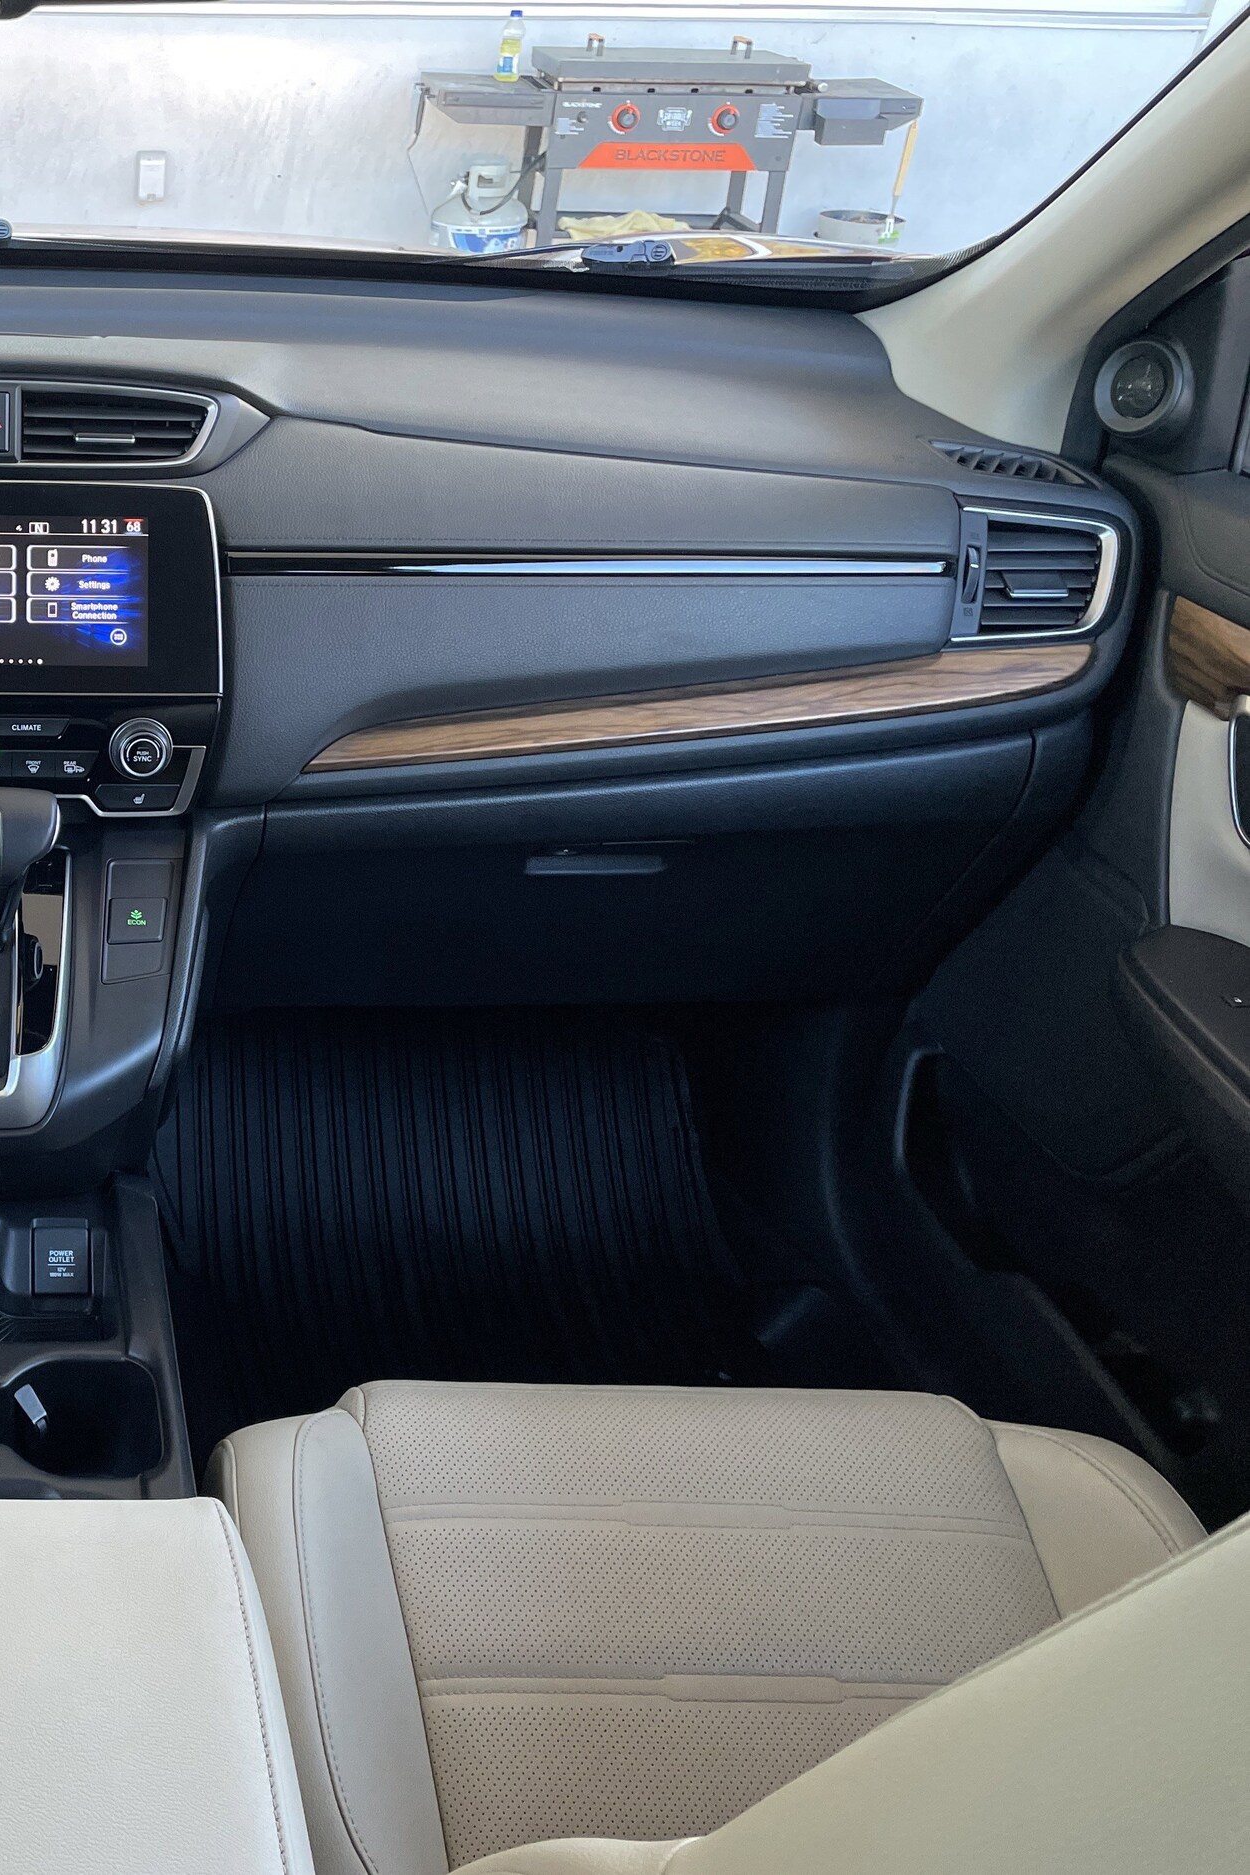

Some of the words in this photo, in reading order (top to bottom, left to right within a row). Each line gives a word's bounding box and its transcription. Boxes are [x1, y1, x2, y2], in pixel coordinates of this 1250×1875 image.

[615, 149, 726, 162] BLACKSTONE
[34, 524, 44, 533] N
[81, 519, 96, 533] 11
[100, 519, 117, 534] 31
[126, 521, 141, 532] 68
[82, 554, 108, 563] Phone
[78, 580, 110, 590] Settings
[71, 602, 118, 611] Smartphone
[72, 611, 117, 620] Connection
